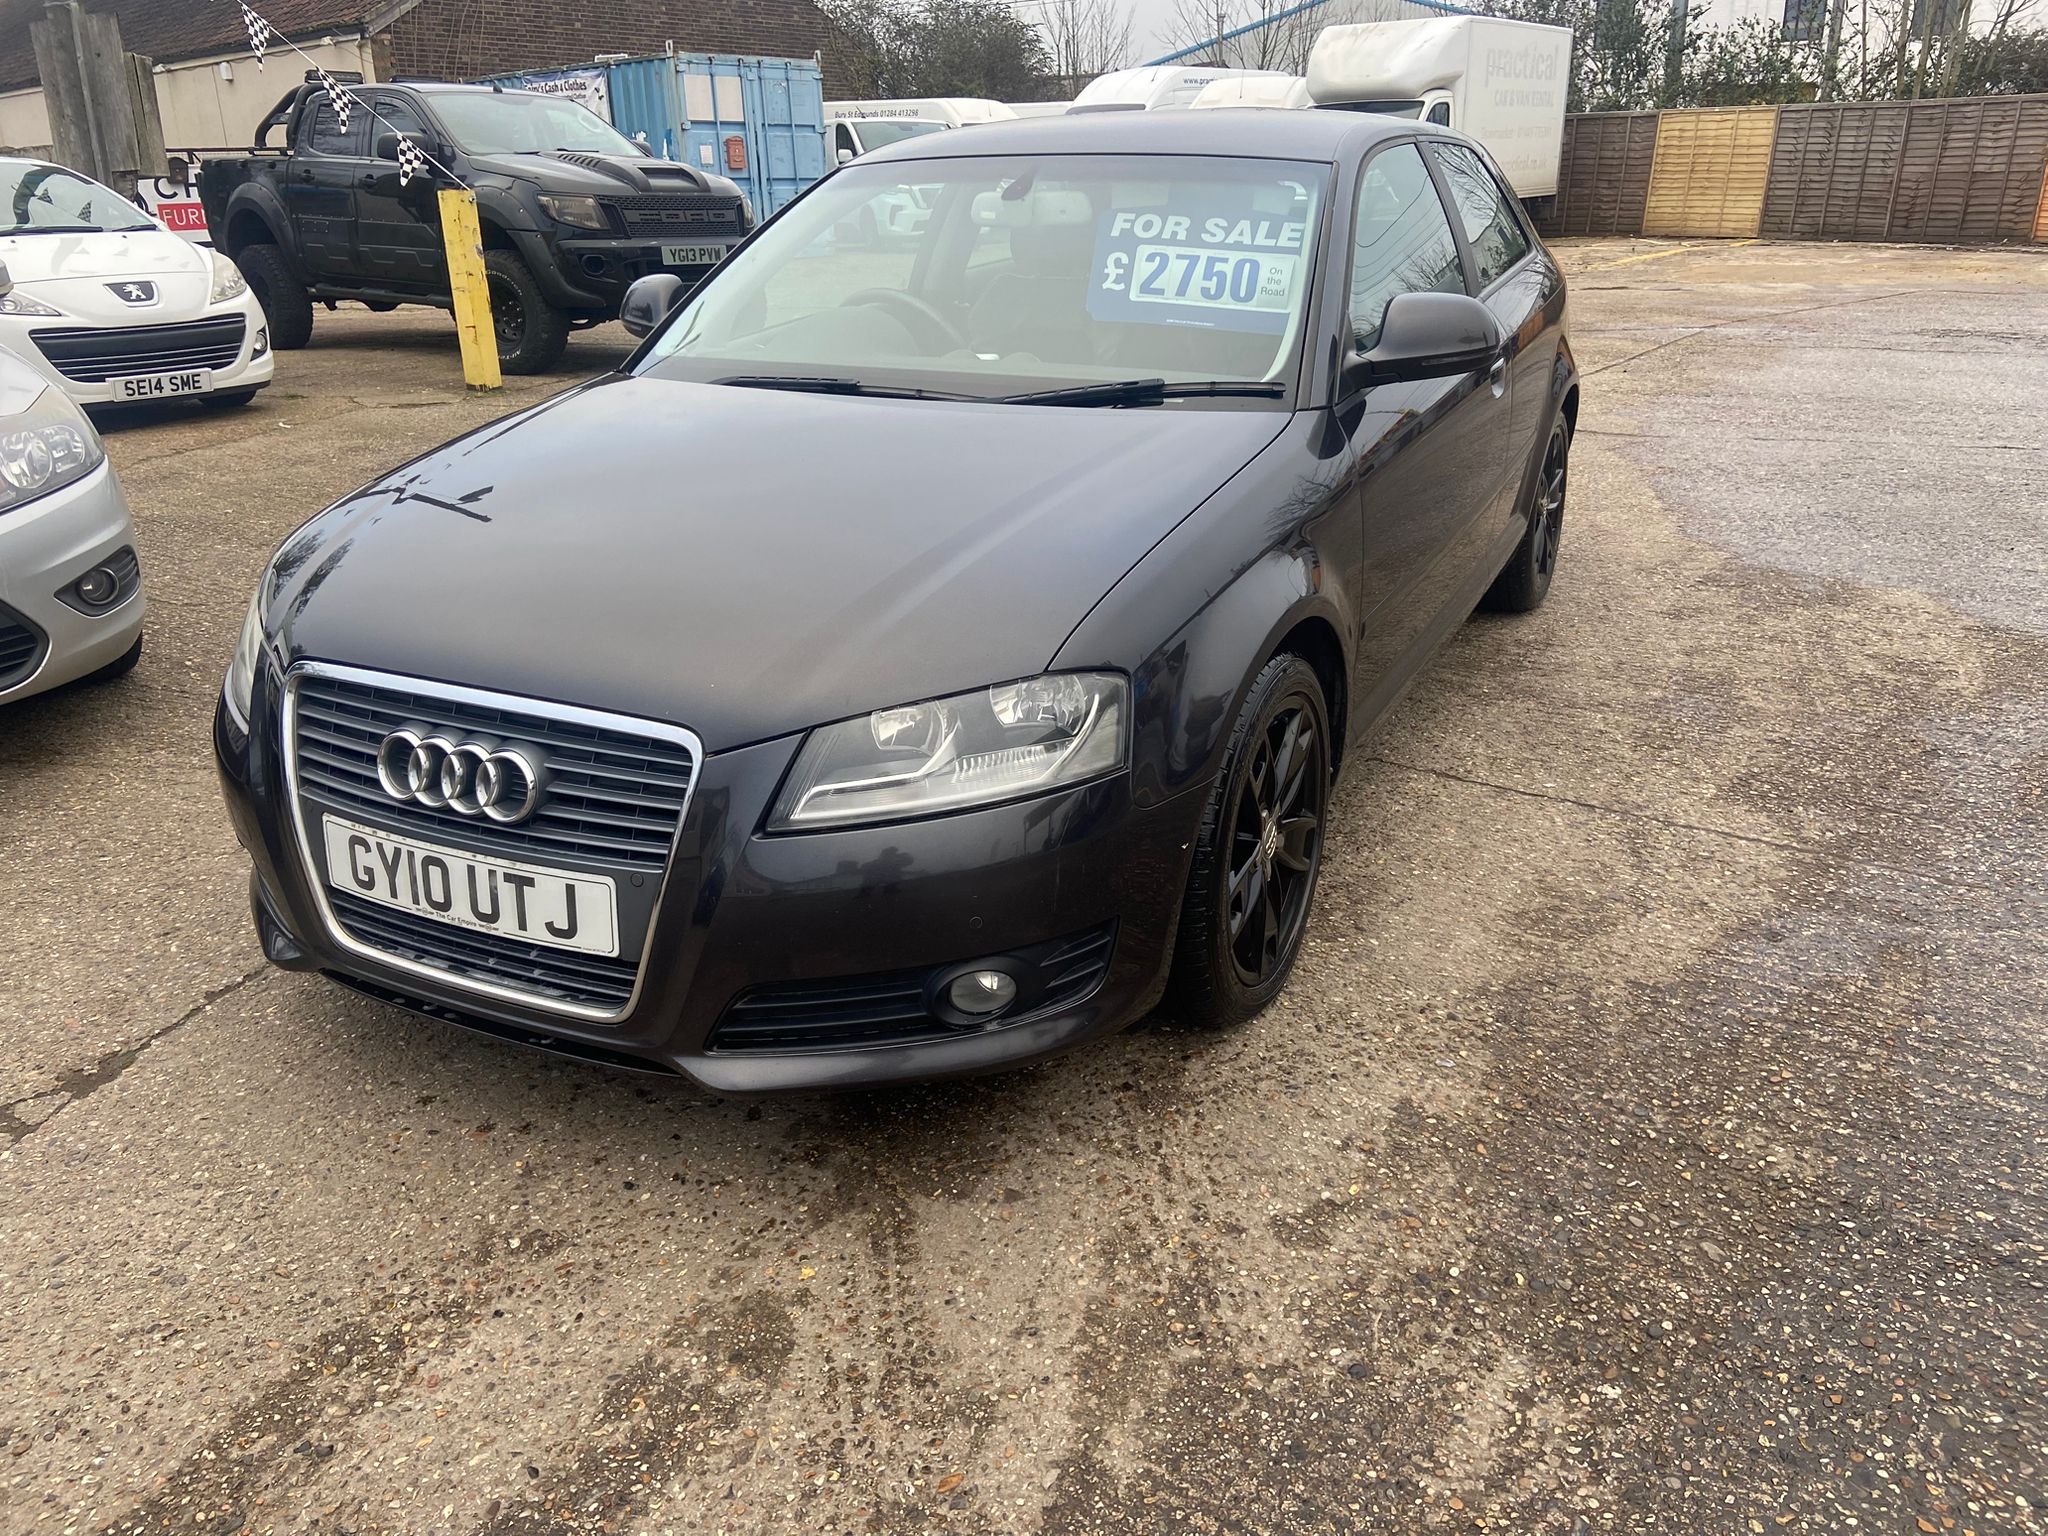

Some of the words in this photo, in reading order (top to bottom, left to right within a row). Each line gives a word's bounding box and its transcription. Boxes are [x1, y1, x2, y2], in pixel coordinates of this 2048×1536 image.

[1486, 44, 1558, 88] practical
[544, 82, 559, 93] Cash
[564, 80, 587, 91] Clothes
[1110, 212, 1191, 240] FOR
[1201, 217, 1306, 248] SALE
[669, 247, 697, 263] YG13
[1269, 266, 1283, 275] On
[1267, 276, 1282, 286] the
[1260, 287, 1285, 298] Road
[124, 378, 164, 397] SE14
[170, 374, 202, 392] SME
[348, 834, 452, 913] GY10
[458, 917, 477, 927] Empire
